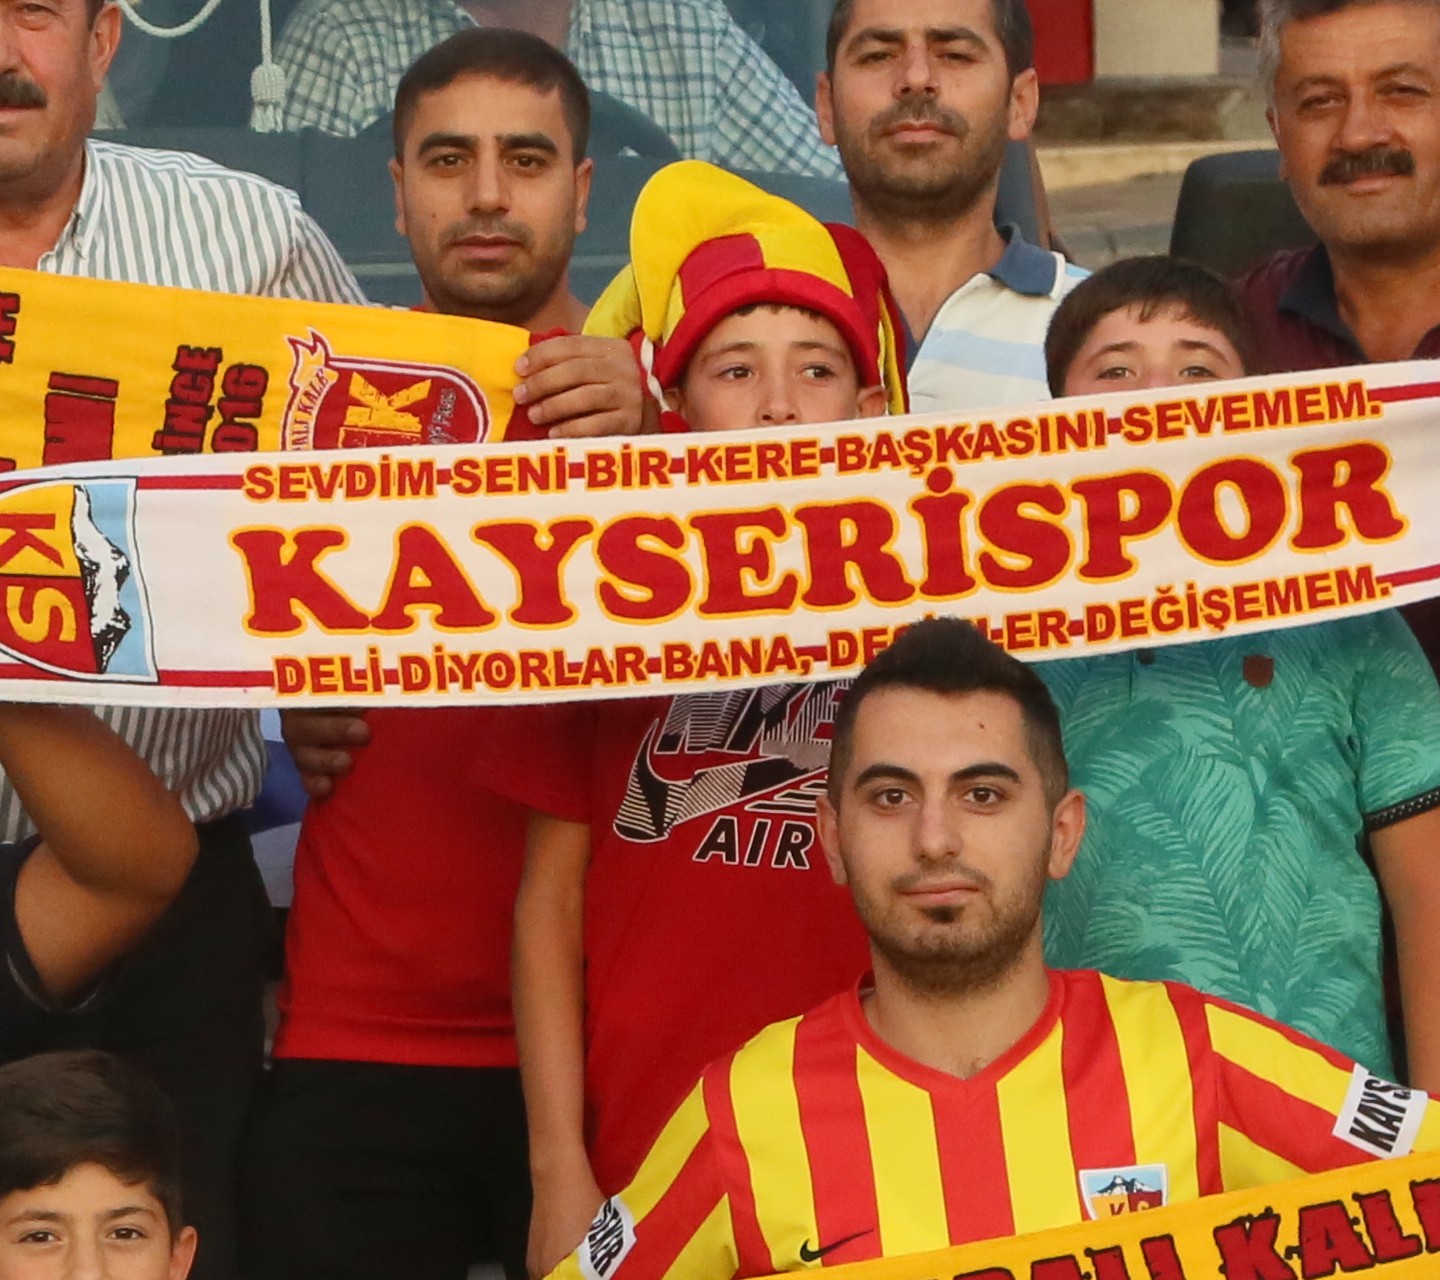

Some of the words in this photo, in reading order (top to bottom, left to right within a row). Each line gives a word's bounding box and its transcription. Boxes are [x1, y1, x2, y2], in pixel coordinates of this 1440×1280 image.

[242, 453, 437, 502] SEVDİM
[451, 446, 568, 495] SENİ
[585, 442, 671, 490] BİR
[686, 438, 823, 485] KERE
[836, 408, 1109, 478] BAŞKASINI
[229, 440, 1408, 638] KAYSERİSPOR
[272, 646, 384, 696] DELİ
[398, 638, 649, 694] DİYORLAR
[684, 814, 808, 871] AIR
